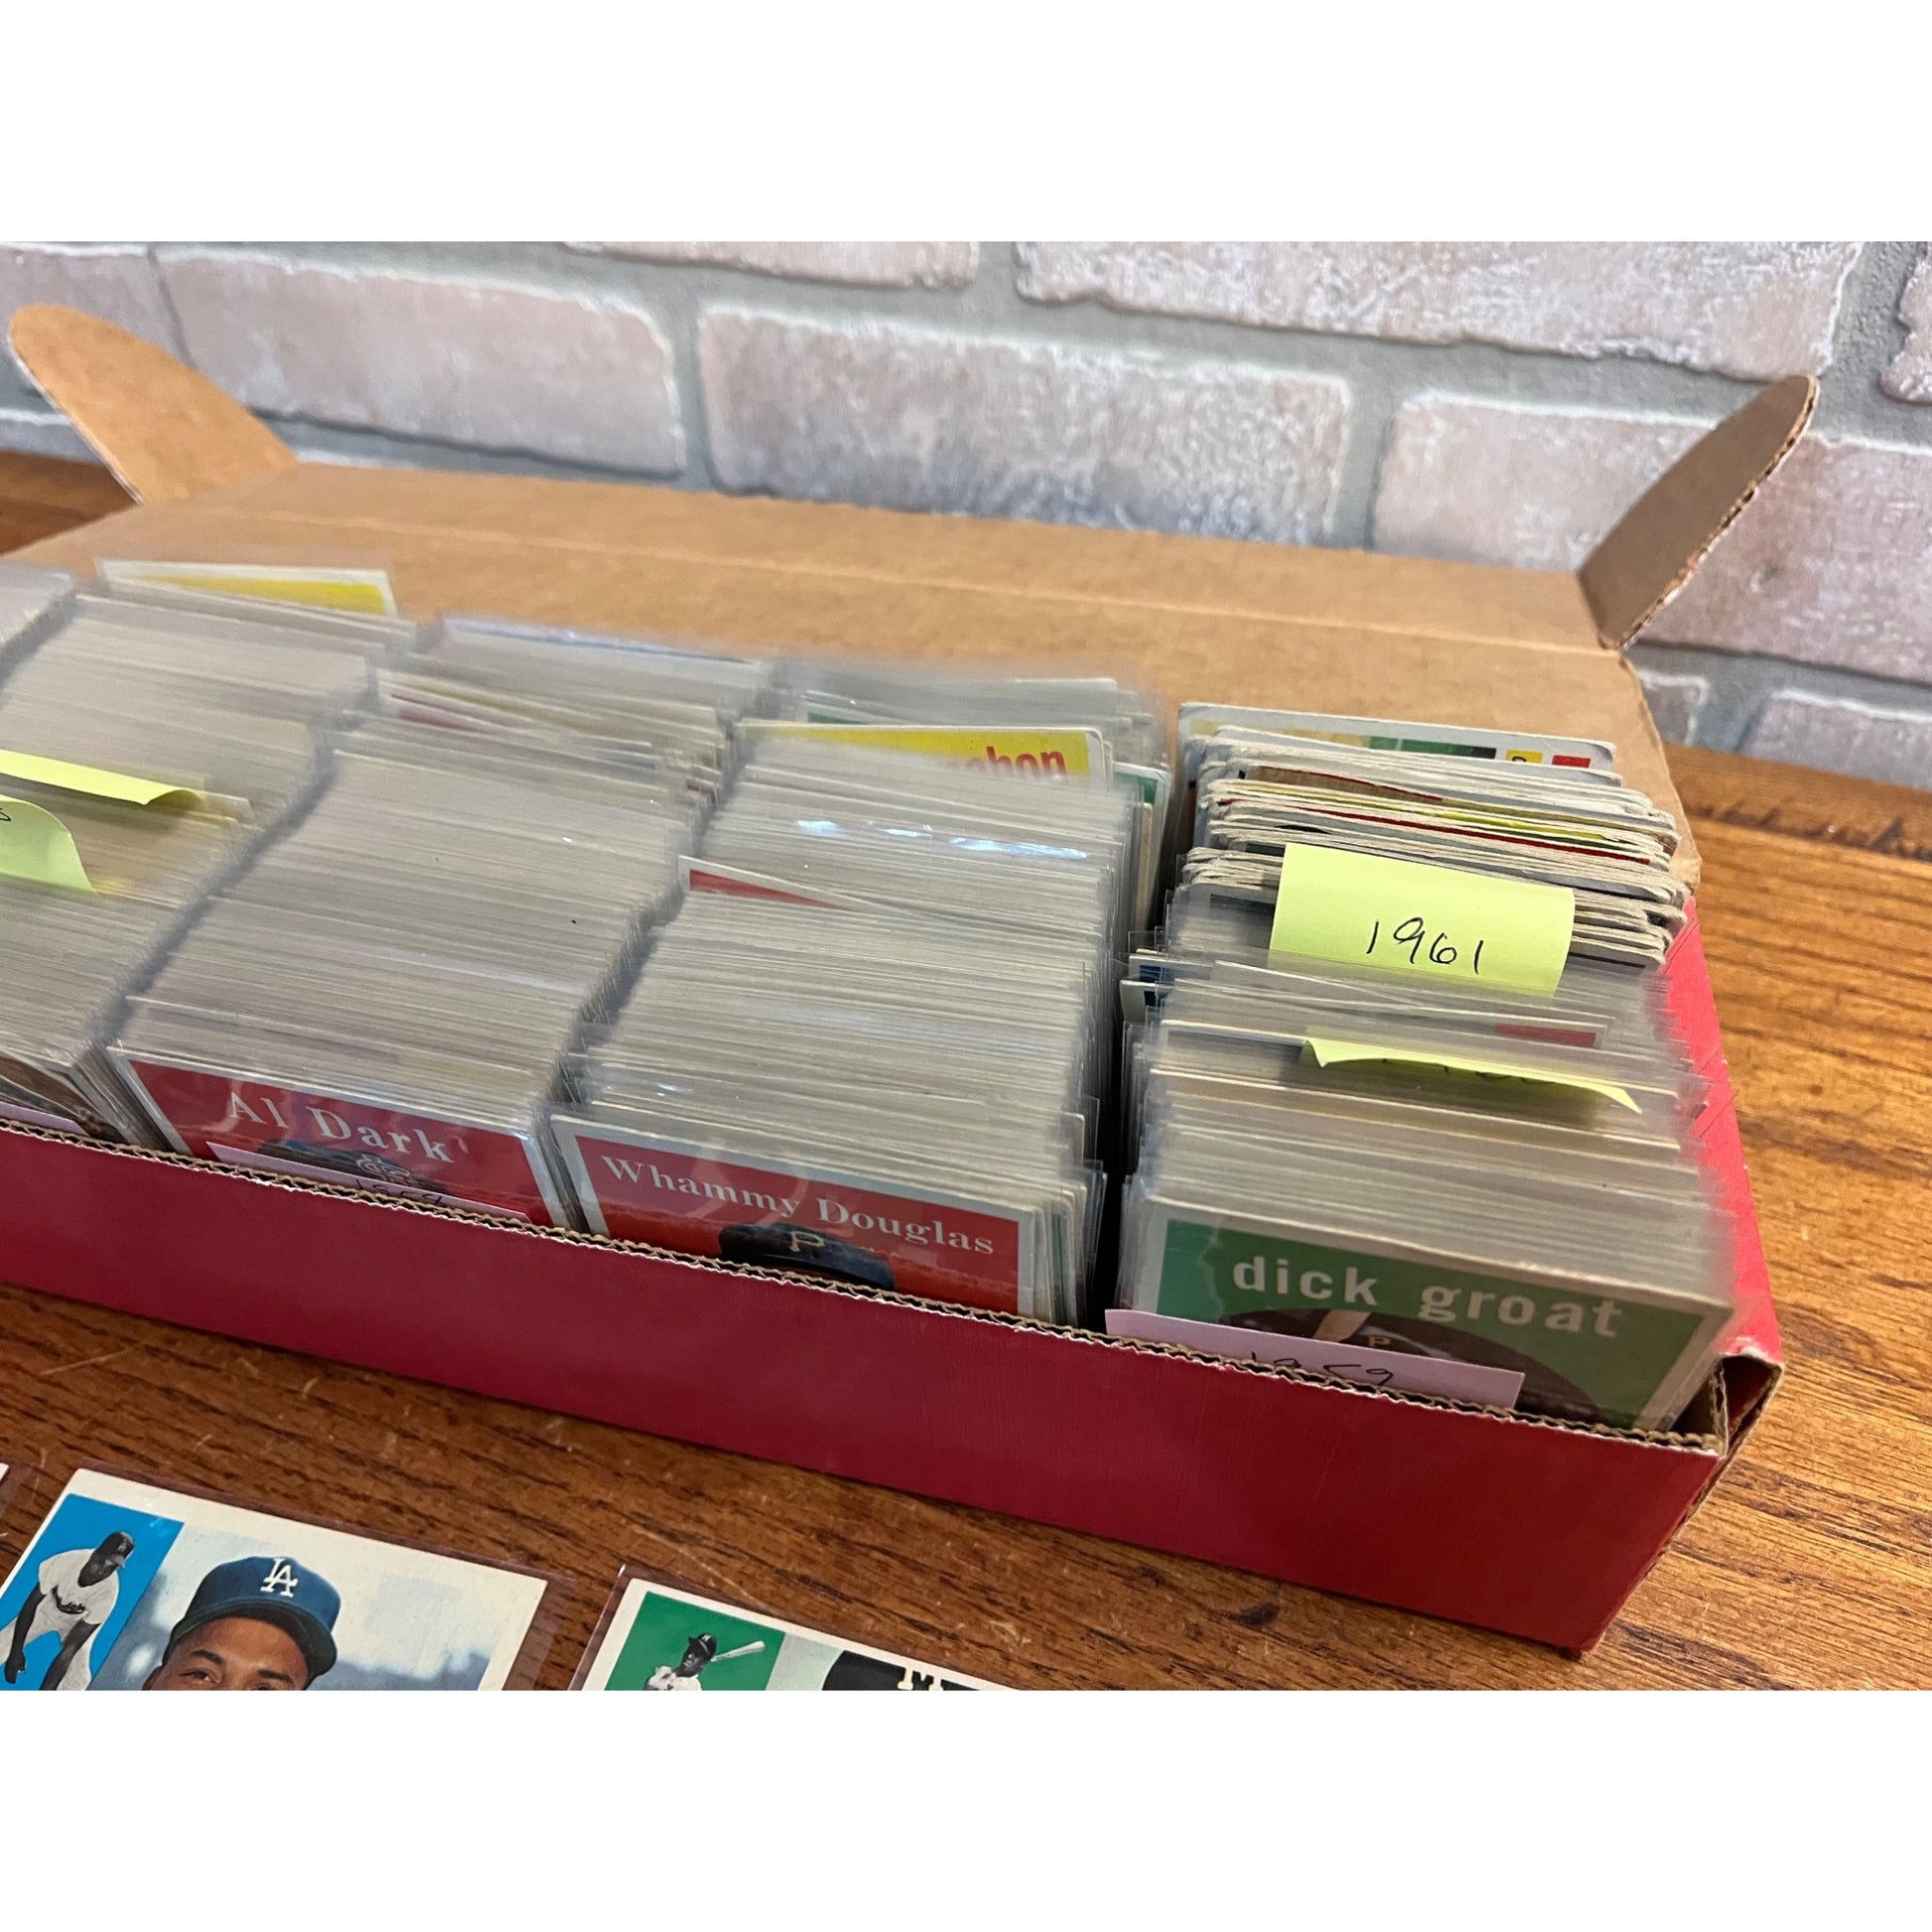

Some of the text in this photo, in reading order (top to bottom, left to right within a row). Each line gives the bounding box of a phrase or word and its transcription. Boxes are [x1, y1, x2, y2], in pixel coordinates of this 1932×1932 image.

[1366, 916, 1484, 974] 1961
[229, 1092, 455, 1164] Al Dark
[601, 1155, 994, 1255] Whammy Douglas
[789, 1230, 825, 1252] P
[1232, 1256, 1627, 1337] dick groat
[260, 1557, 298, 1597] LA
